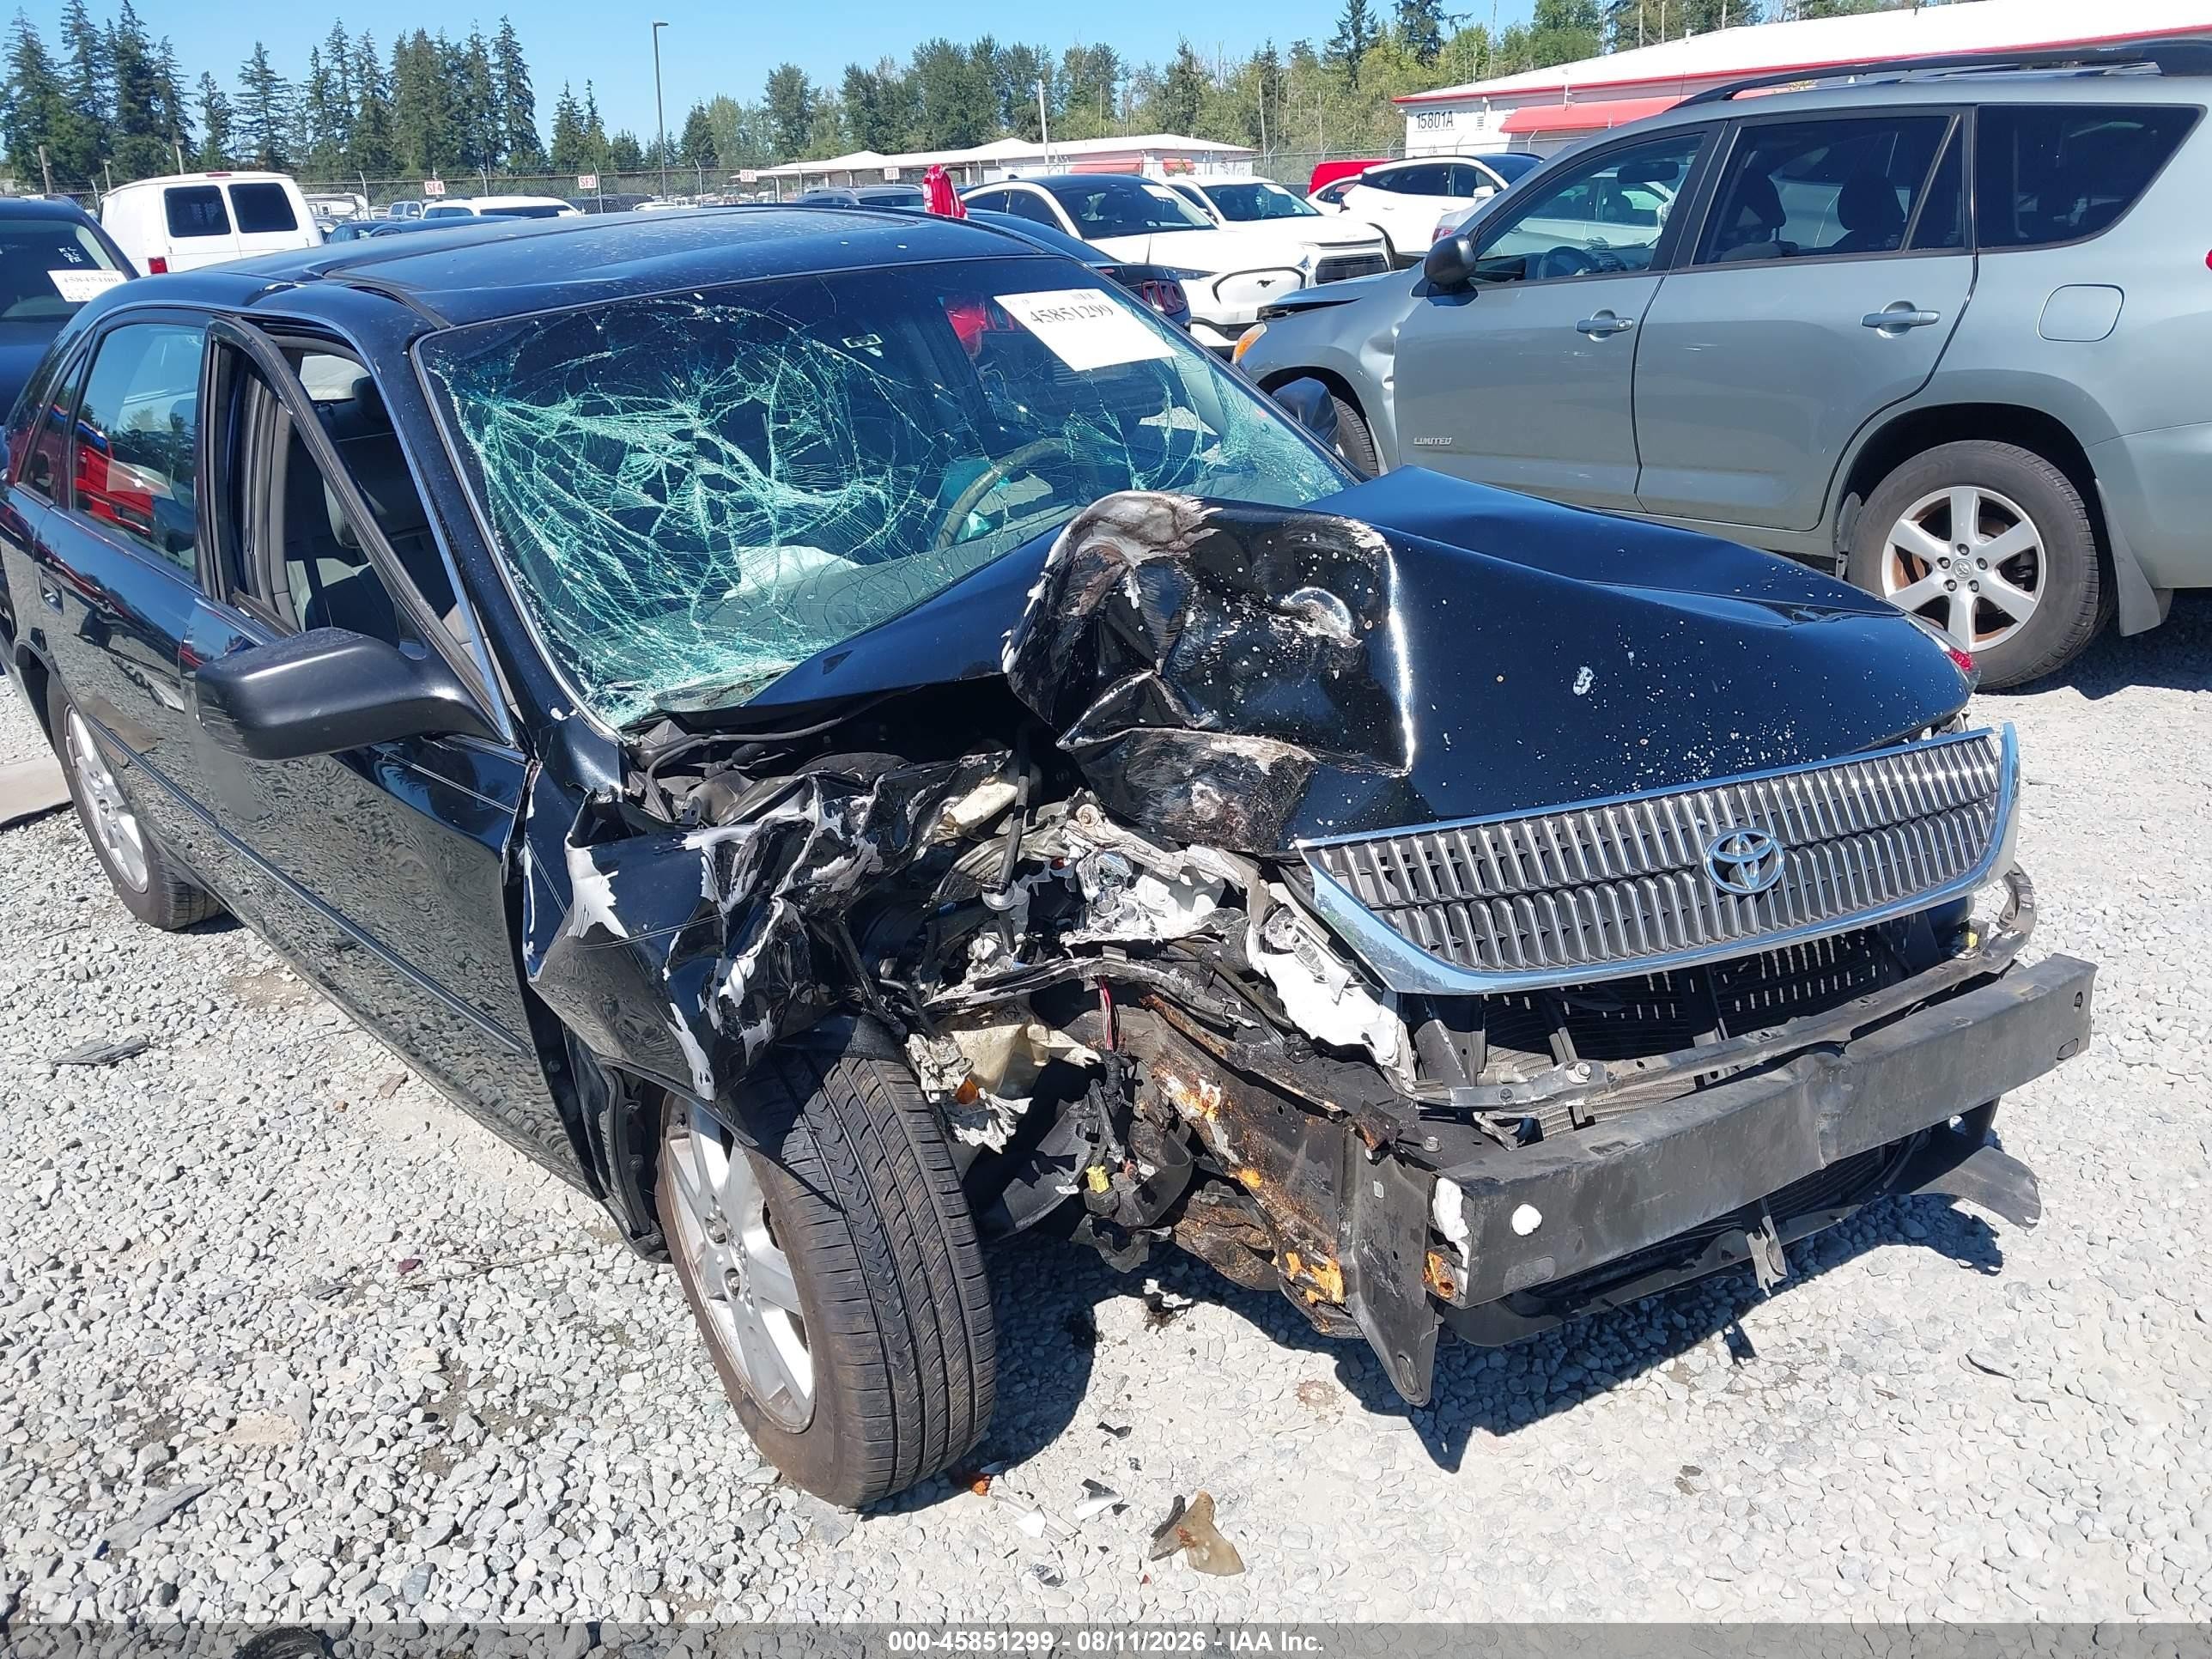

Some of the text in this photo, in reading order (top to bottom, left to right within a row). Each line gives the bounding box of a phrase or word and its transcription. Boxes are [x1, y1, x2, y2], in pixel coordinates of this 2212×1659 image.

[1416, 110, 1454, 130] 15801A
[741, 171, 756, 180] SF2
[580, 177, 595, 187] SF3
[426, 182, 443, 193] SF4
[1030, 303, 1114, 324] 45851299
[1413, 436, 1452, 446] LIMITED
